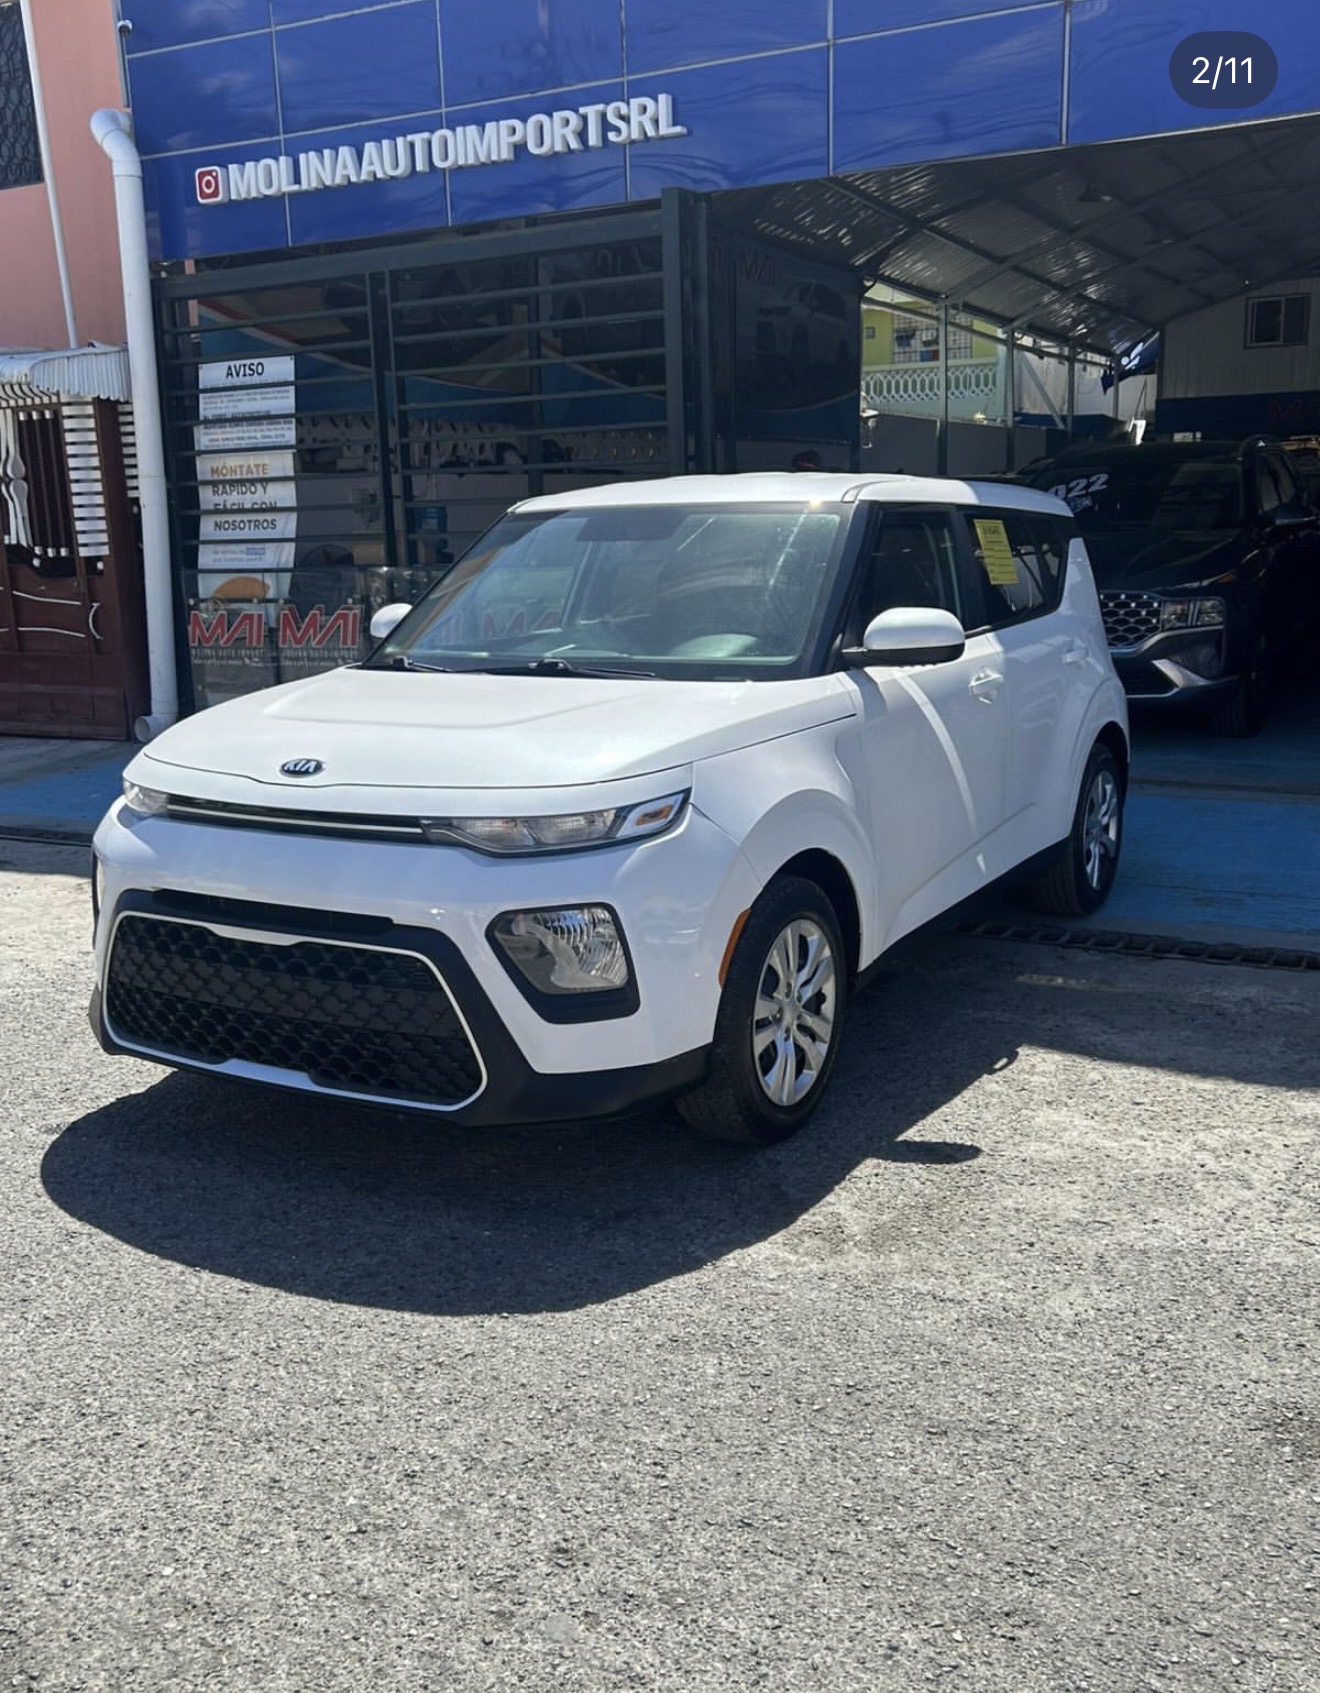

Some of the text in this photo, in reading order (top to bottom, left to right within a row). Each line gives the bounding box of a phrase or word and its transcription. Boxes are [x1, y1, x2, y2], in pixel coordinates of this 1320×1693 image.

[228, 93, 687, 201] MOLINAAUTOIMPORTSRL
[226, 362, 265, 379] AVISO
[210, 462, 270, 478] MÓNTATE
[260, 482, 269, 495] Y
[213, 519, 278, 532] NOSOTROS
[189, 610, 265, 647] MAI
[278, 610, 361, 648] MAI
[283, 759, 318, 773] KIA
